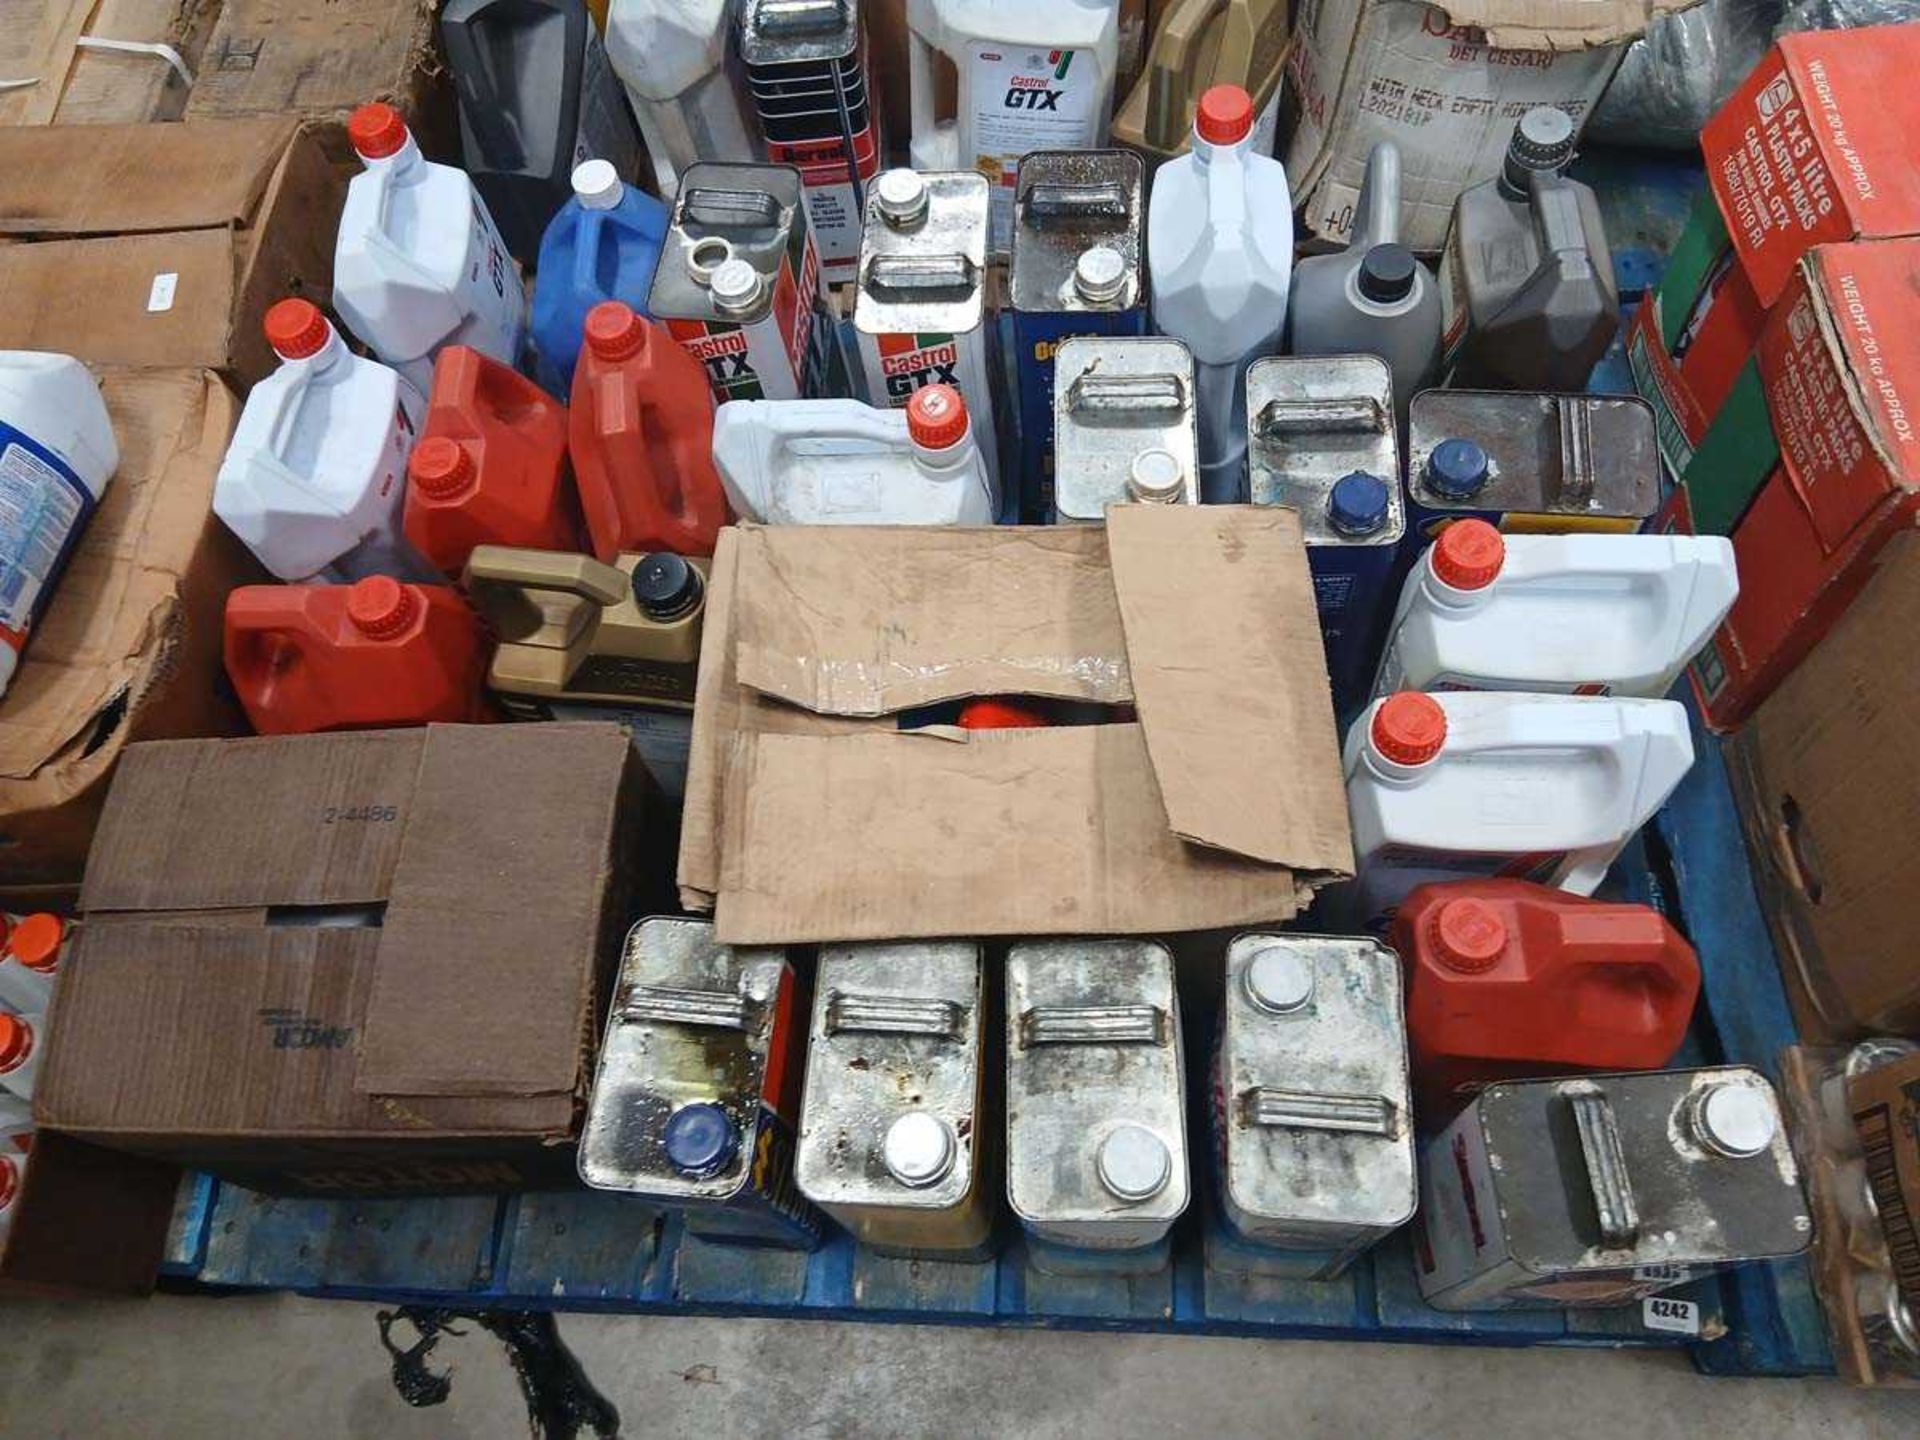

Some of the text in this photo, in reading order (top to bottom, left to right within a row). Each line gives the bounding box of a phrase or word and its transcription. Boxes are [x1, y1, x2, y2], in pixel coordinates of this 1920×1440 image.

[1010, 75, 1049, 88] Castrol
[1003, 88, 1064, 112] GTX
[1783, 108, 1801, 127] 4
[1807, 58, 1837, 114] WEIGHT
[1827, 111, 1845, 130] 20
[1841, 147, 1877, 201] APPROX
[1793, 137, 1813, 160] 5
[1745, 127, 1776, 197] CASTROL
[1769, 196, 1793, 232] GTX
[1766, 123, 1795, 184] PLASTIC
[1787, 180, 1818, 232] PACKS
[1802, 157, 1833, 216] litre
[681, 332, 748, 361] astrol
[881, 344, 958, 376] Castrol
[1839, 275, 1873, 339] WEIGHT
[1861, 335, 1880, 358] 20
[1876, 377, 1915, 443] APPROX
[704, 351, 756, 378] TX
[886, 362, 960, 397] GTX
[1651, 1300, 1690, 1320] 4242
